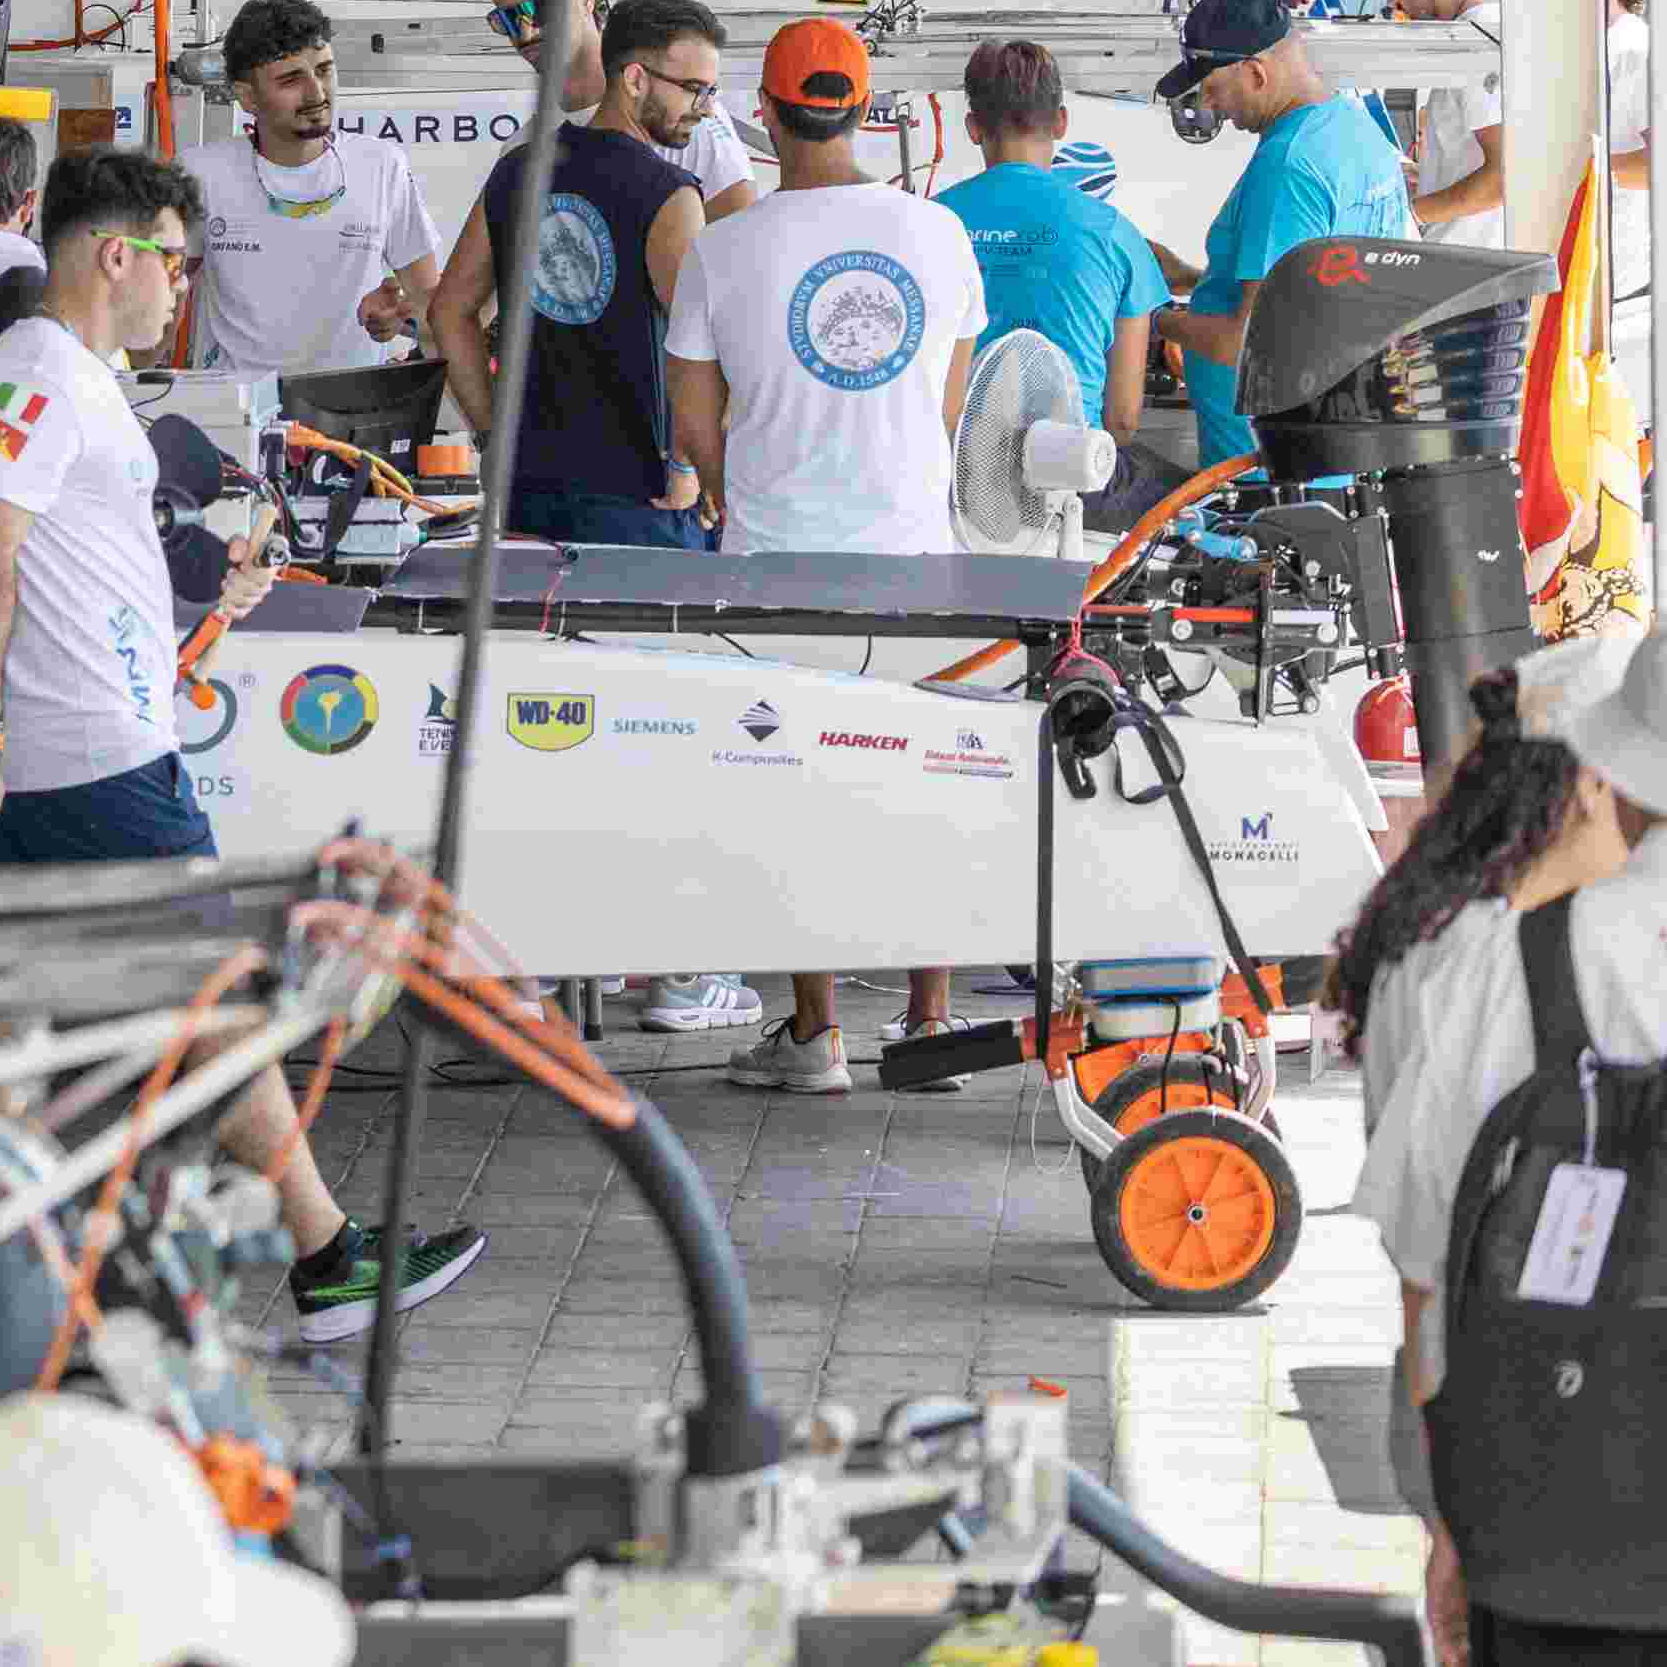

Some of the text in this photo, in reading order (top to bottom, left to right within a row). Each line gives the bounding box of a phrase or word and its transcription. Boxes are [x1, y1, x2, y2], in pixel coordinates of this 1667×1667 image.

[516, 700, 587, 726] WD-40
[611, 718, 698, 736] SIEMENS
[818, 731, 909, 752] HARKEN
